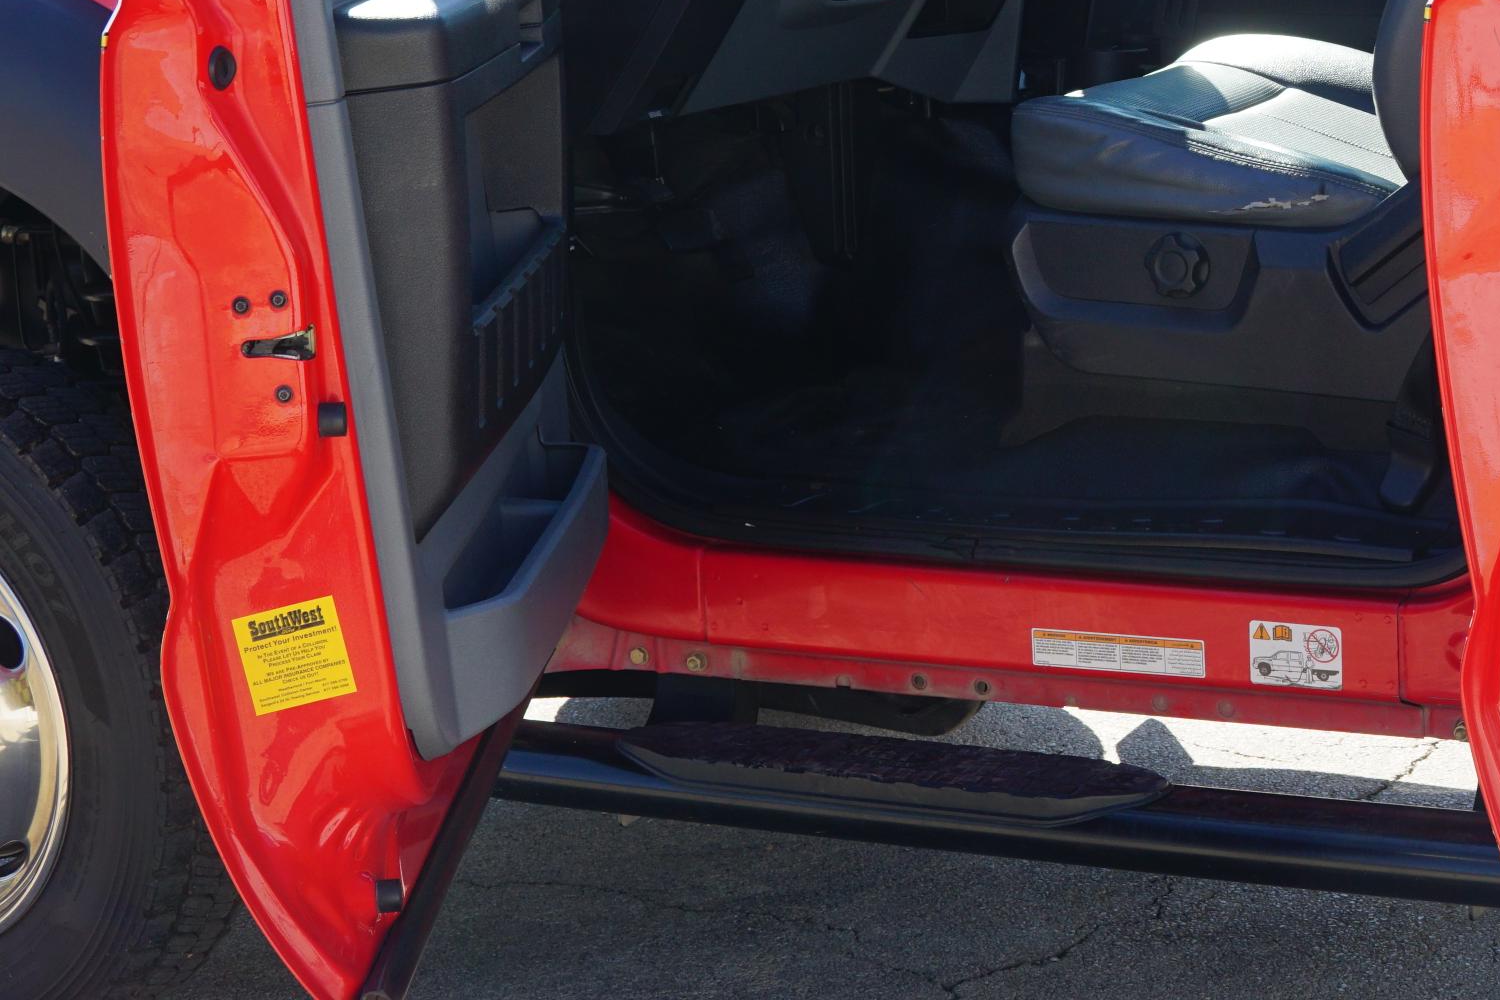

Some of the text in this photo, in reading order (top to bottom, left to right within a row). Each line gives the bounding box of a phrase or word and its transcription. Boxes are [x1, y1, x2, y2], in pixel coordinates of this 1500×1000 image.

[248, 605, 323, 637] SouthWest
[244, 626, 337, 653] Protect Your Investment!
[274, 647, 290, 656] EVENT
[314, 644, 325, 652] YOU
[264, 675, 283, 684] MAJOR
[283, 668, 315, 679] INSURANCE
[315, 660, 345, 671] COMPANIES
